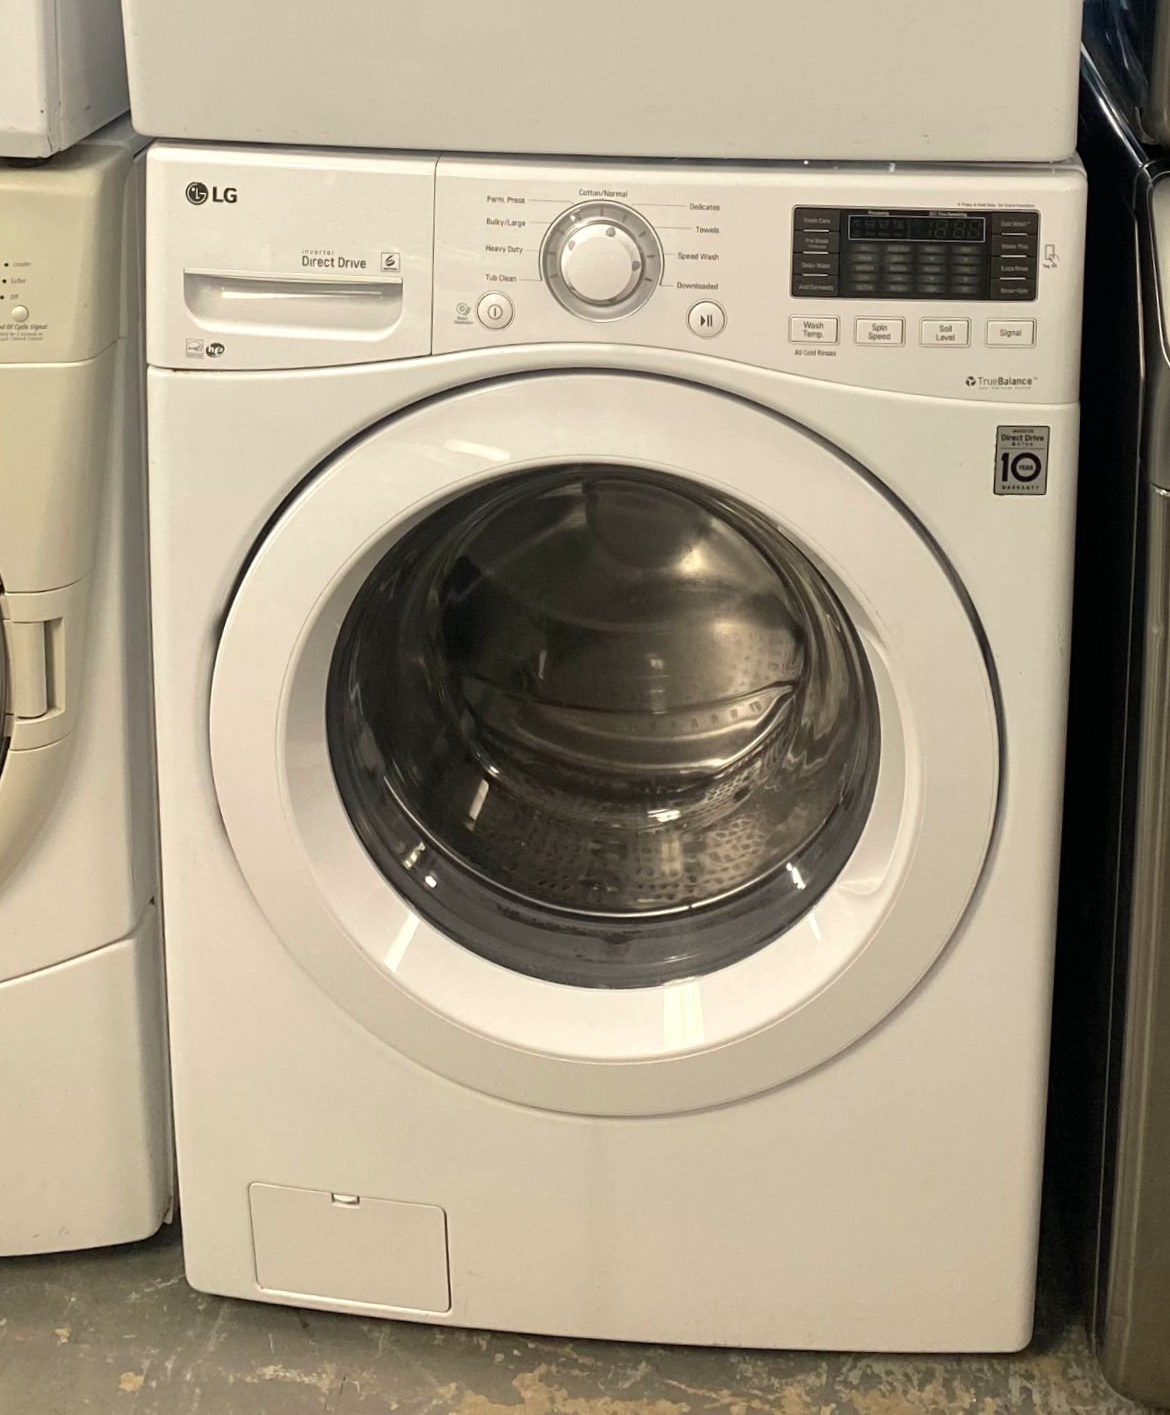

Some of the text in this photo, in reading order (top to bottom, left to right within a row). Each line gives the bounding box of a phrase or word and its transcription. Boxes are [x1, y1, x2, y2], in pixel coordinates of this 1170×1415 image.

[212, 186, 238, 204] LG
[578, 188, 628, 198] Cotton/Normal
[507, 196, 525, 204] Press
[689, 203, 720, 211] Delicates
[486, 218, 526, 227] Bulky/Large
[696, 226, 720, 234] Towels
[485, 244, 523, 254] Heavy Duty
[678, 252, 720, 261] Speed Wash
[302, 255, 367, 269] Direct Drive
[485, 274, 517, 283] Tub Clean
[677, 282, 719, 290] Downloaded
[803, 321, 824, 330] Wash
[871, 323, 888, 332] Spin
[939, 325, 952, 333] Soil
[868, 332, 891, 341] Speed
[936, 333, 955, 341] Level
[999, 329, 1022, 338] Signal
[1001, 434, 1044, 442] Direct Drive
[1001, 452, 1042, 483] 10
